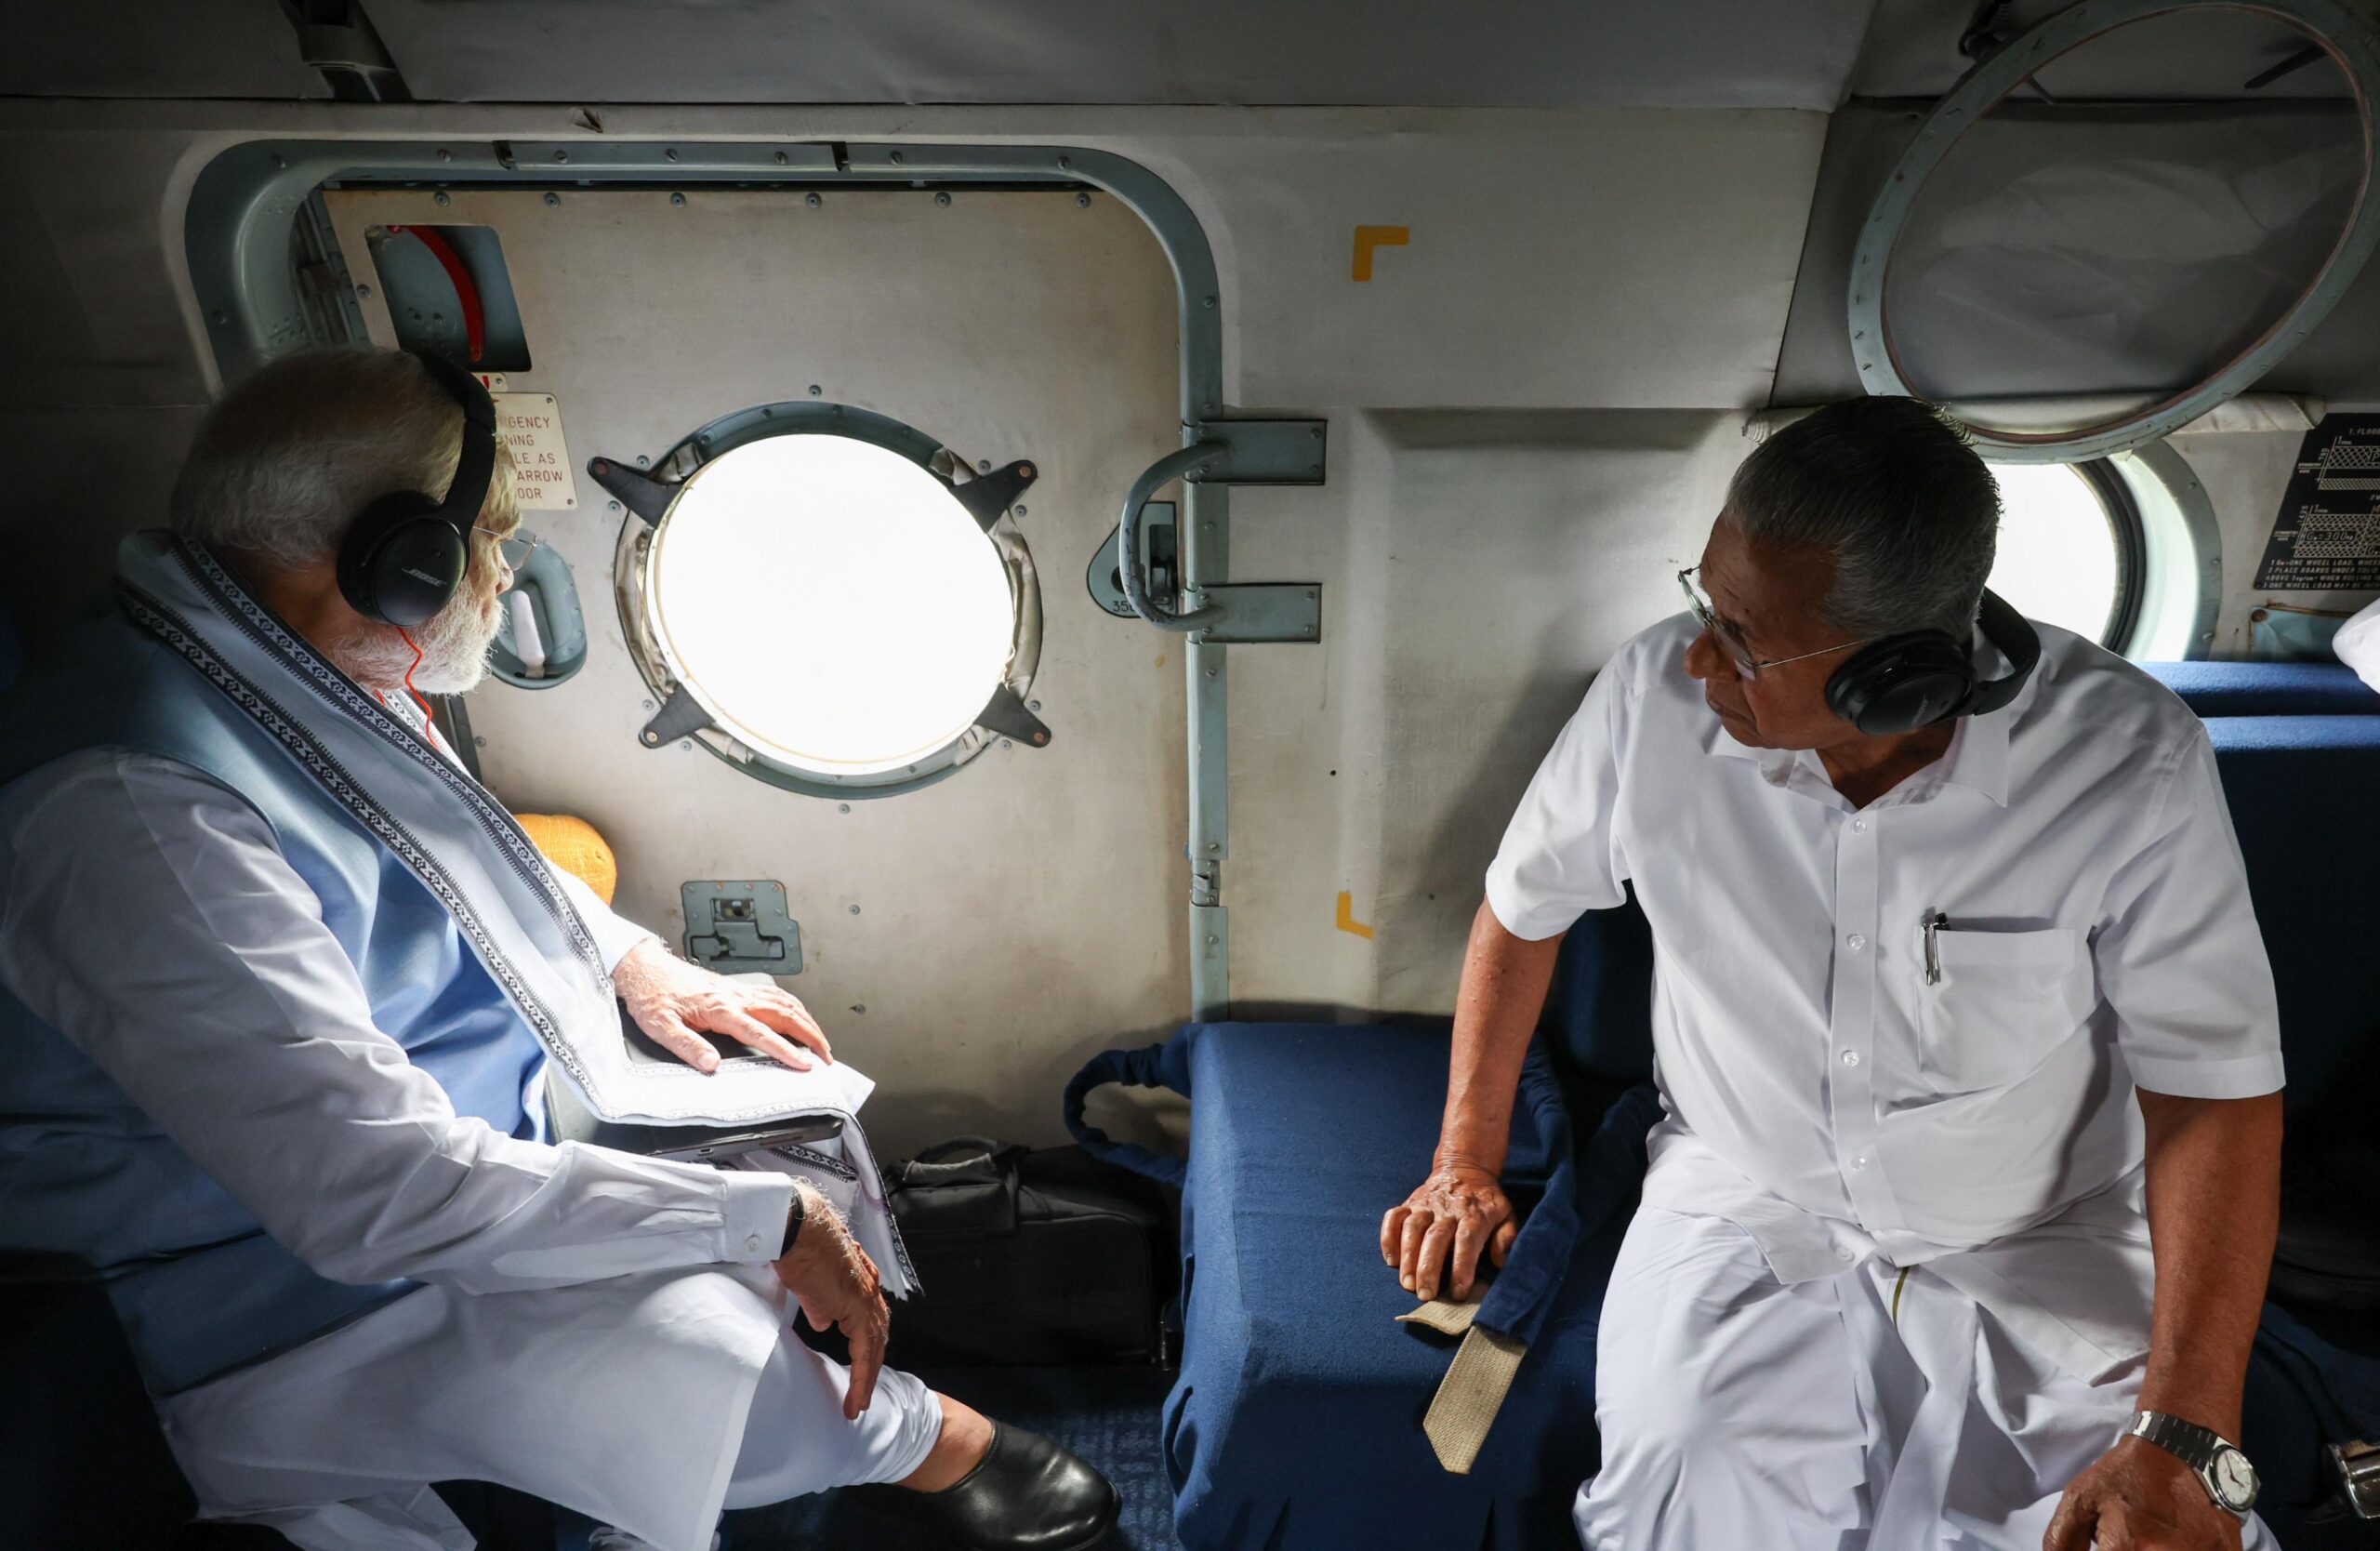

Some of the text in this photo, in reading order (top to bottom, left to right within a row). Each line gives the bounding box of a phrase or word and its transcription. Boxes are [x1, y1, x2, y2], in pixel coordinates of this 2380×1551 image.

[507, 417, 550, 429] GENCY
[538, 453, 556, 465] AS
[517, 487, 542, 499] OOR
